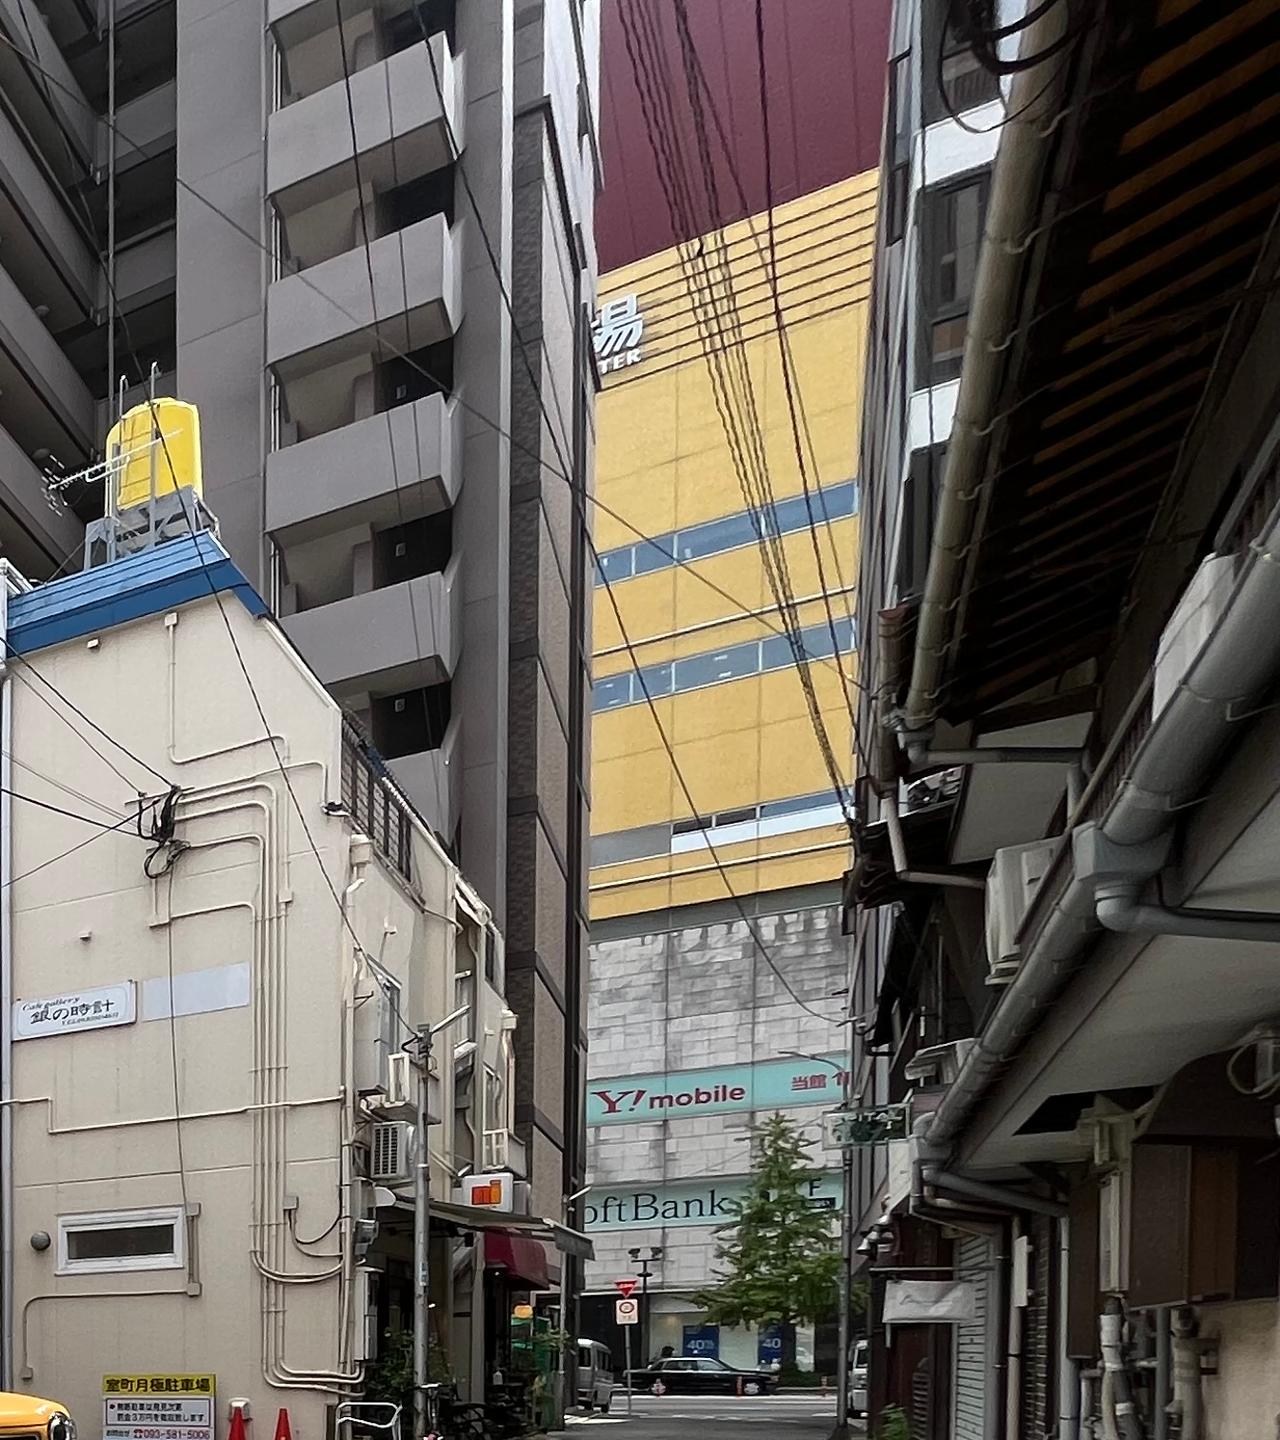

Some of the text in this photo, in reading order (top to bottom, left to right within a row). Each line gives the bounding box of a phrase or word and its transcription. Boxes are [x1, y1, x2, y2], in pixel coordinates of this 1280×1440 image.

[106, 1378, 211, 1392] 室町月極駐車場
